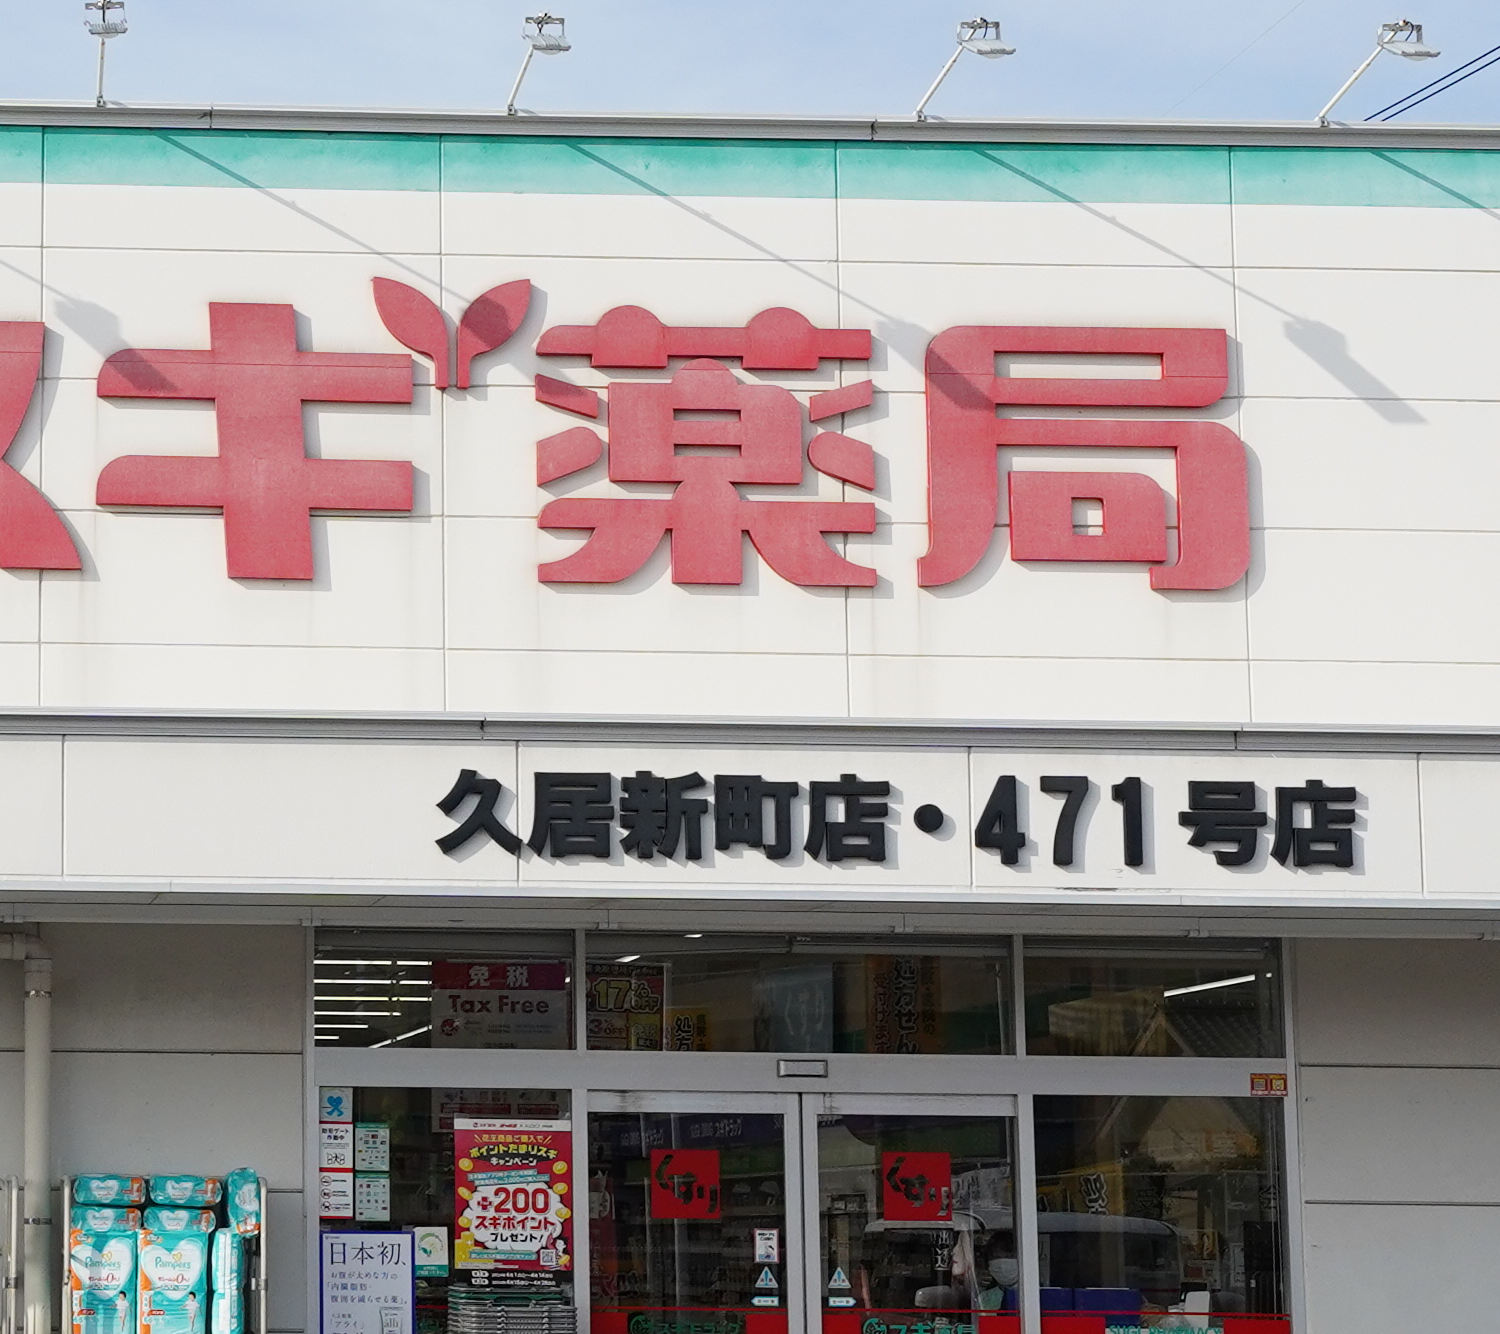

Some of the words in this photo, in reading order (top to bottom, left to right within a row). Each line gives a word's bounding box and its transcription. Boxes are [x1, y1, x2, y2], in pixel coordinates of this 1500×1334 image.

[468, 966, 529, 987] 免税
[448, 995, 492, 1013] Tax
[498, 995, 549, 1013] Free
[490, 1157, 537, 1166] キャンペーン
[655, 1154, 718, 1213] くすり
[475, 1216, 555, 1231] スギポイント
[85, 1257, 121, 1270] Pampers
[155, 1257, 191, 1270] Pampers
